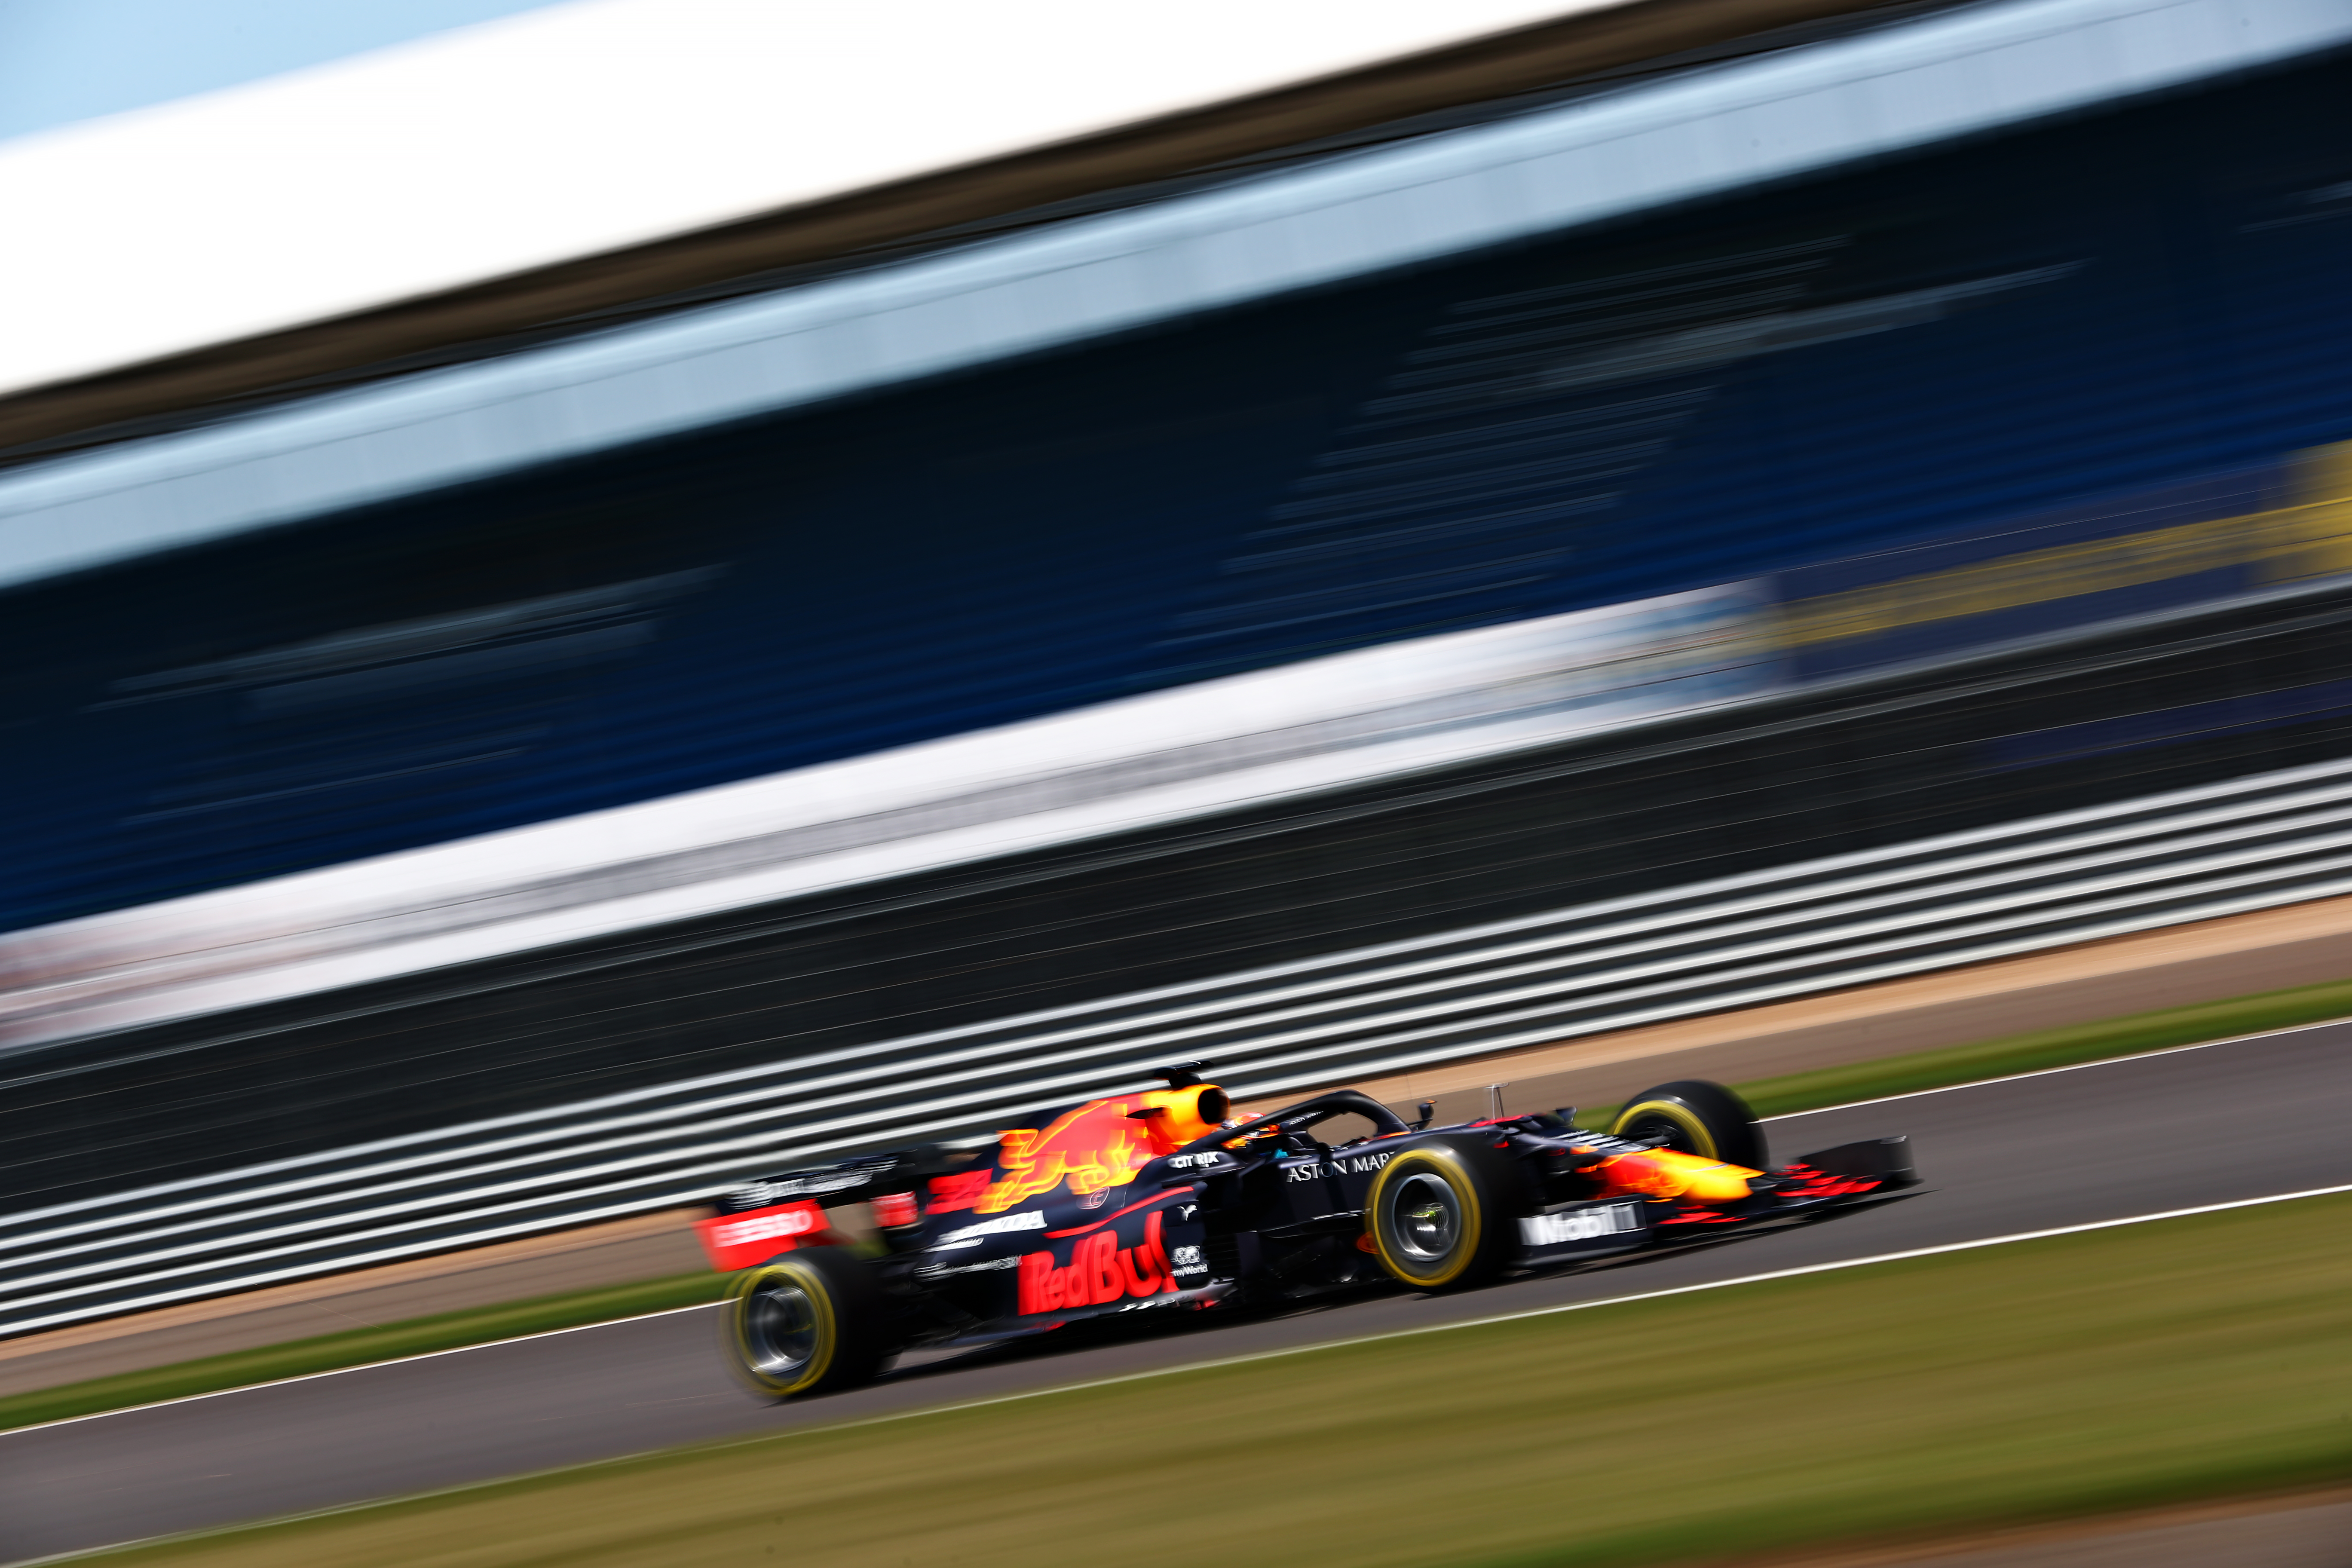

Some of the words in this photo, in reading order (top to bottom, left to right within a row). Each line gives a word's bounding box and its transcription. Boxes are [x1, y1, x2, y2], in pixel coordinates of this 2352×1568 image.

[1168, 1151, 1219, 1168] CITRIX
[1286, 1159, 1348, 1183] ASTON
[1350, 1151, 1395, 1173] MAR
[1517, 1204, 1618, 1246] Mobil
[1170, 1264, 1208, 1277] myWorld
